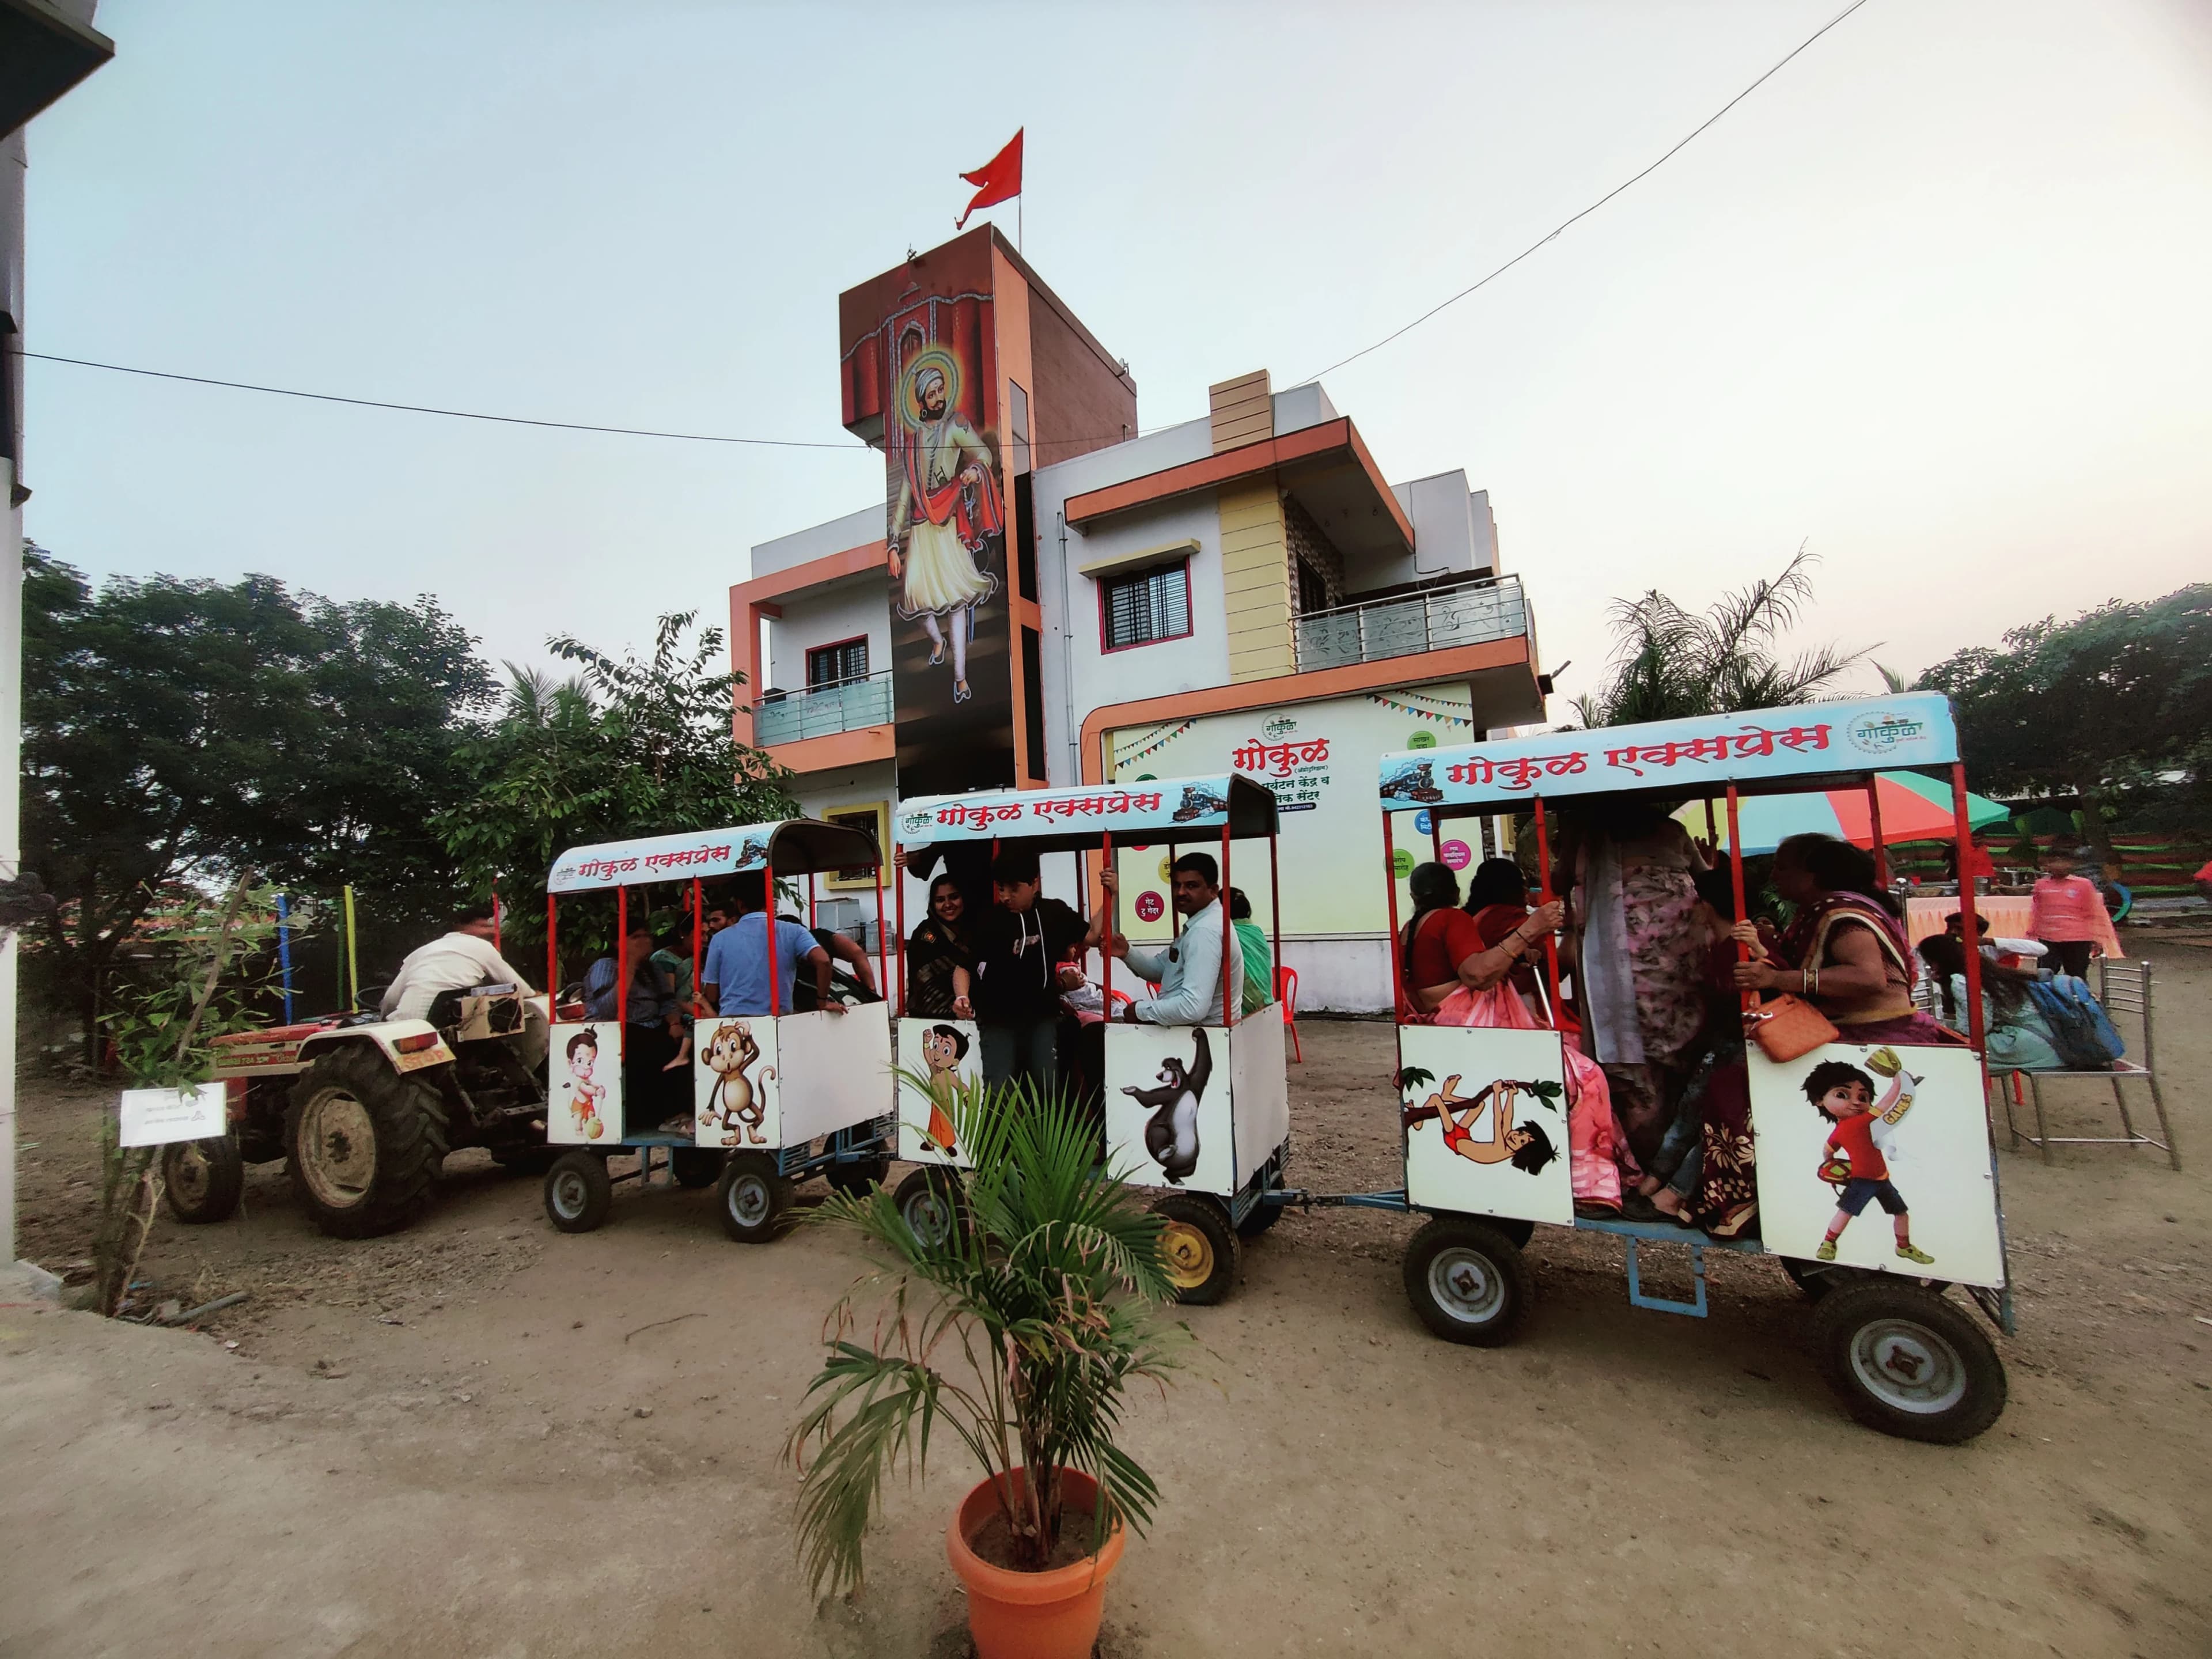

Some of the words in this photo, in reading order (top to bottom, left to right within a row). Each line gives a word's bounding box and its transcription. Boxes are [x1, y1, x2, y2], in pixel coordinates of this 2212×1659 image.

[1232, 738, 1330, 778] गोकुळ
[1446, 751, 1588, 790] गोकुळ
[1604, 724, 1832, 777] एक्सप्रेस
[1296, 790, 1320, 801] सेंटर
[1298, 776, 1317, 787] केंद्र
[1321, 777, 1330, 785] व
[937, 803, 1024, 831] गोकुळ
[1033, 790, 1163, 824] एक्सप्रेस
[578, 858, 639, 881] गोकुळ
[645, 844, 732, 873] एक्सप्रेस
[1883, 1093, 1912, 1124] GAMES
